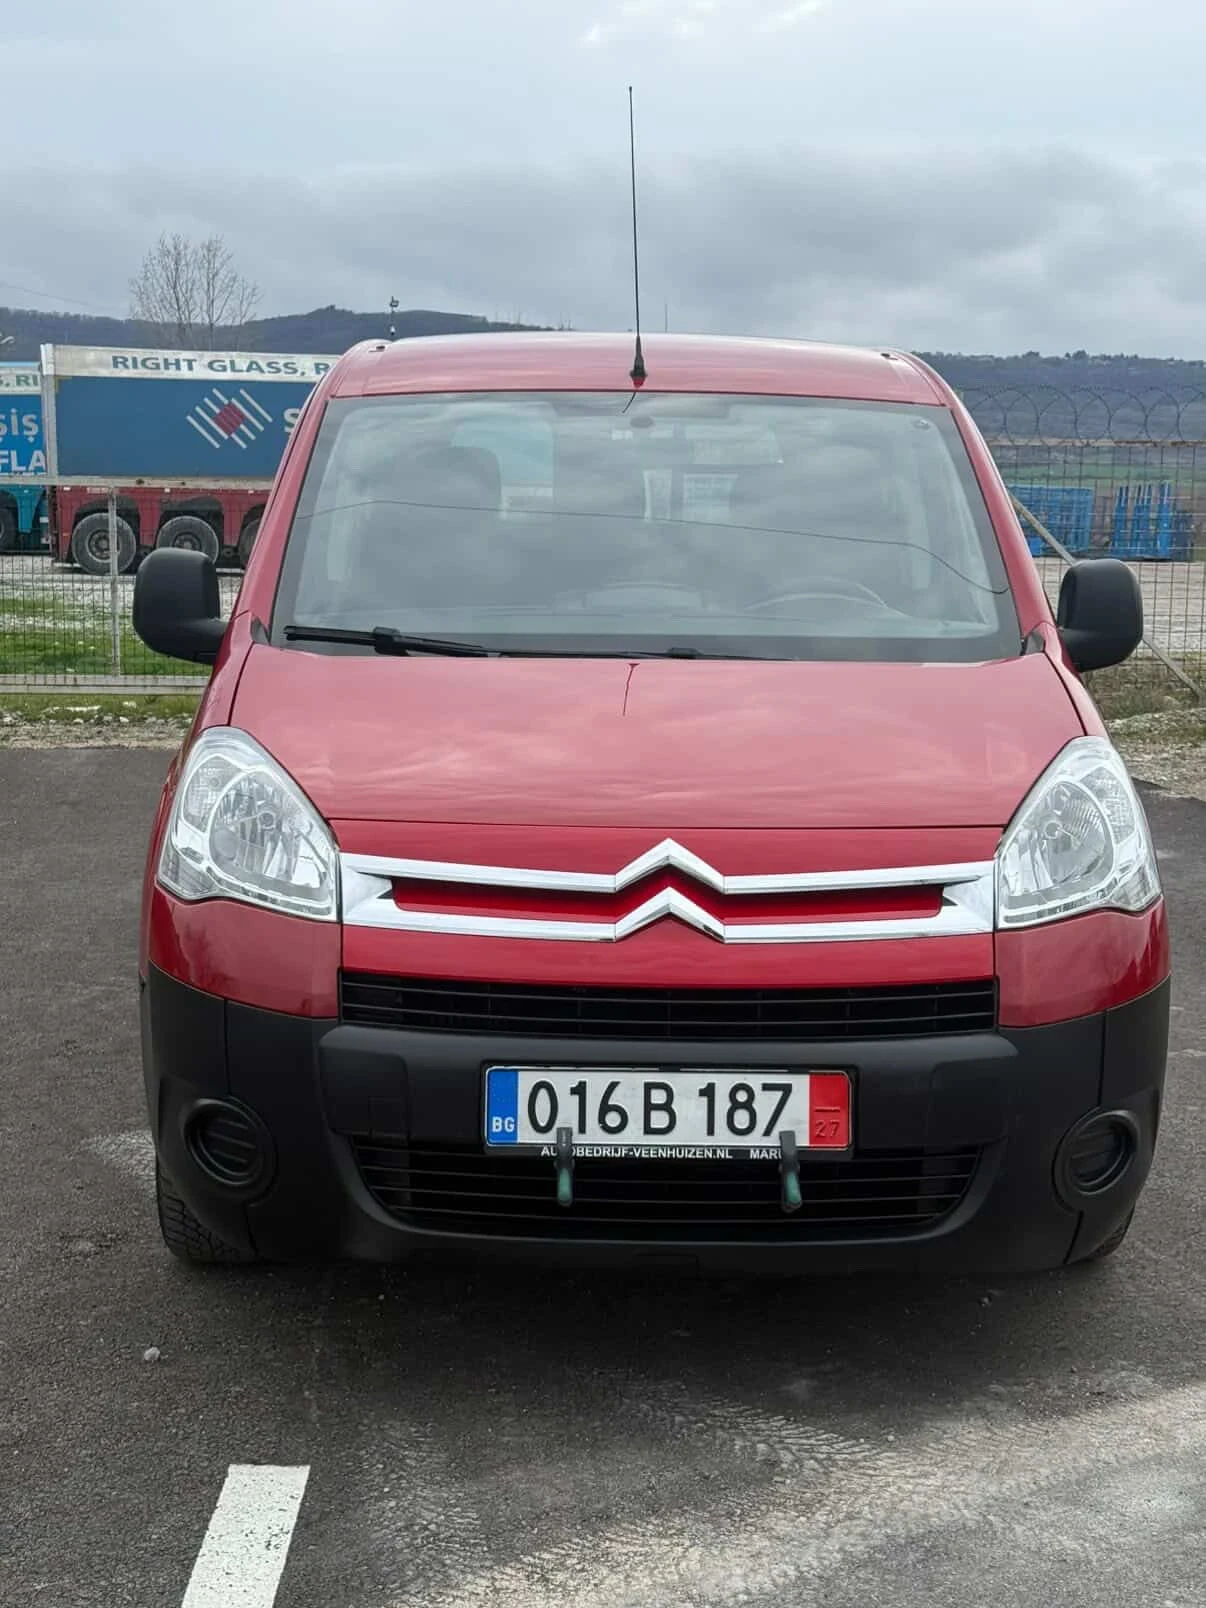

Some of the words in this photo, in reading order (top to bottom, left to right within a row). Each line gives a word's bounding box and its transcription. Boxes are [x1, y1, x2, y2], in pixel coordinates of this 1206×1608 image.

[112, 355, 197, 371] RIGHT
[207, 359, 306, 376] GLASS,
[527, 1080, 629, 1135] 016
[643, 1081, 677, 1135] B
[698, 1082, 793, 1137] 187
[491, 1117, 515, 1132] BG
[814, 1120, 841, 1138] 27
[540, 1145, 733, 1160] AUBEDRIJF-VEENHUIZEN.NL
[749, 1148, 782, 1160] MAR
